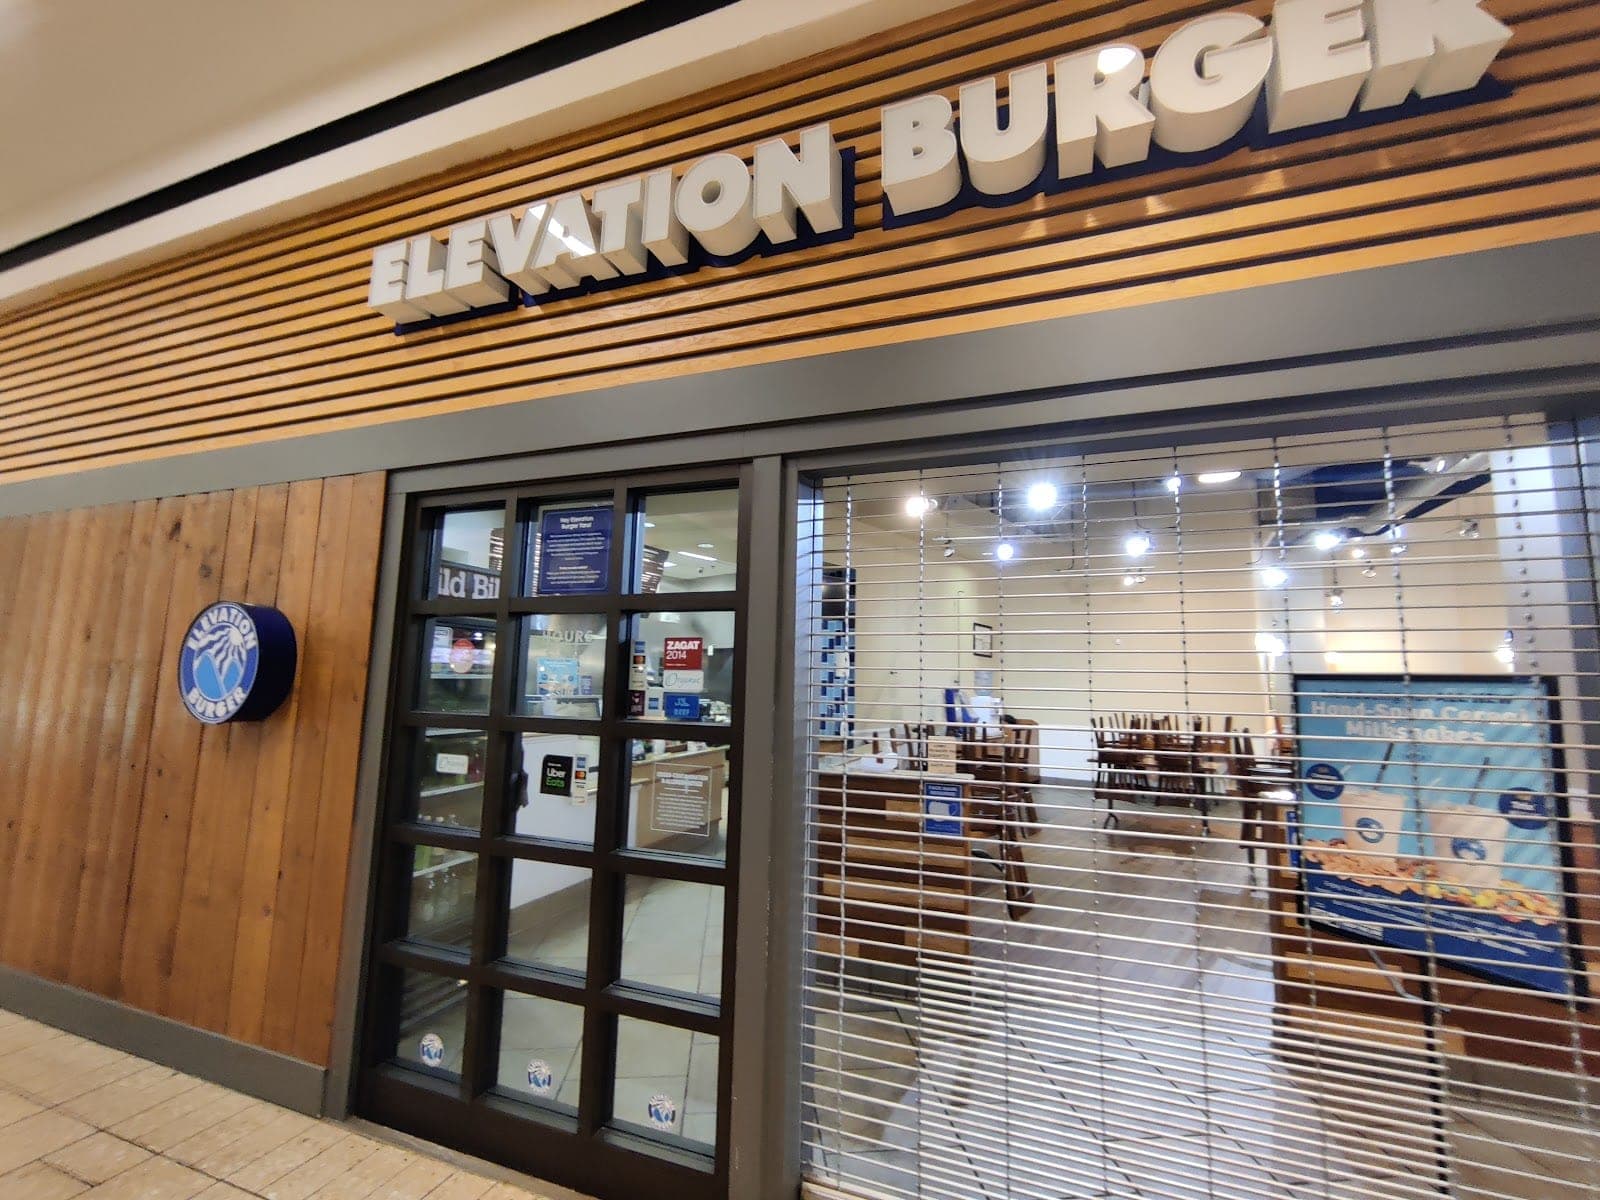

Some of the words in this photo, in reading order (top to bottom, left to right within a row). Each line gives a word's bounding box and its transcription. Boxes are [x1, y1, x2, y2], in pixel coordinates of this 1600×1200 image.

[368, 123, 842, 324] ELEVATION
[186, 606, 257, 651] ELEVATION
[666, 640, 700, 650] ZAGAT
[666, 650, 687, 660] 2014
[187, 686, 247, 718] BURGER
[546, 767, 567, 778] Uber
